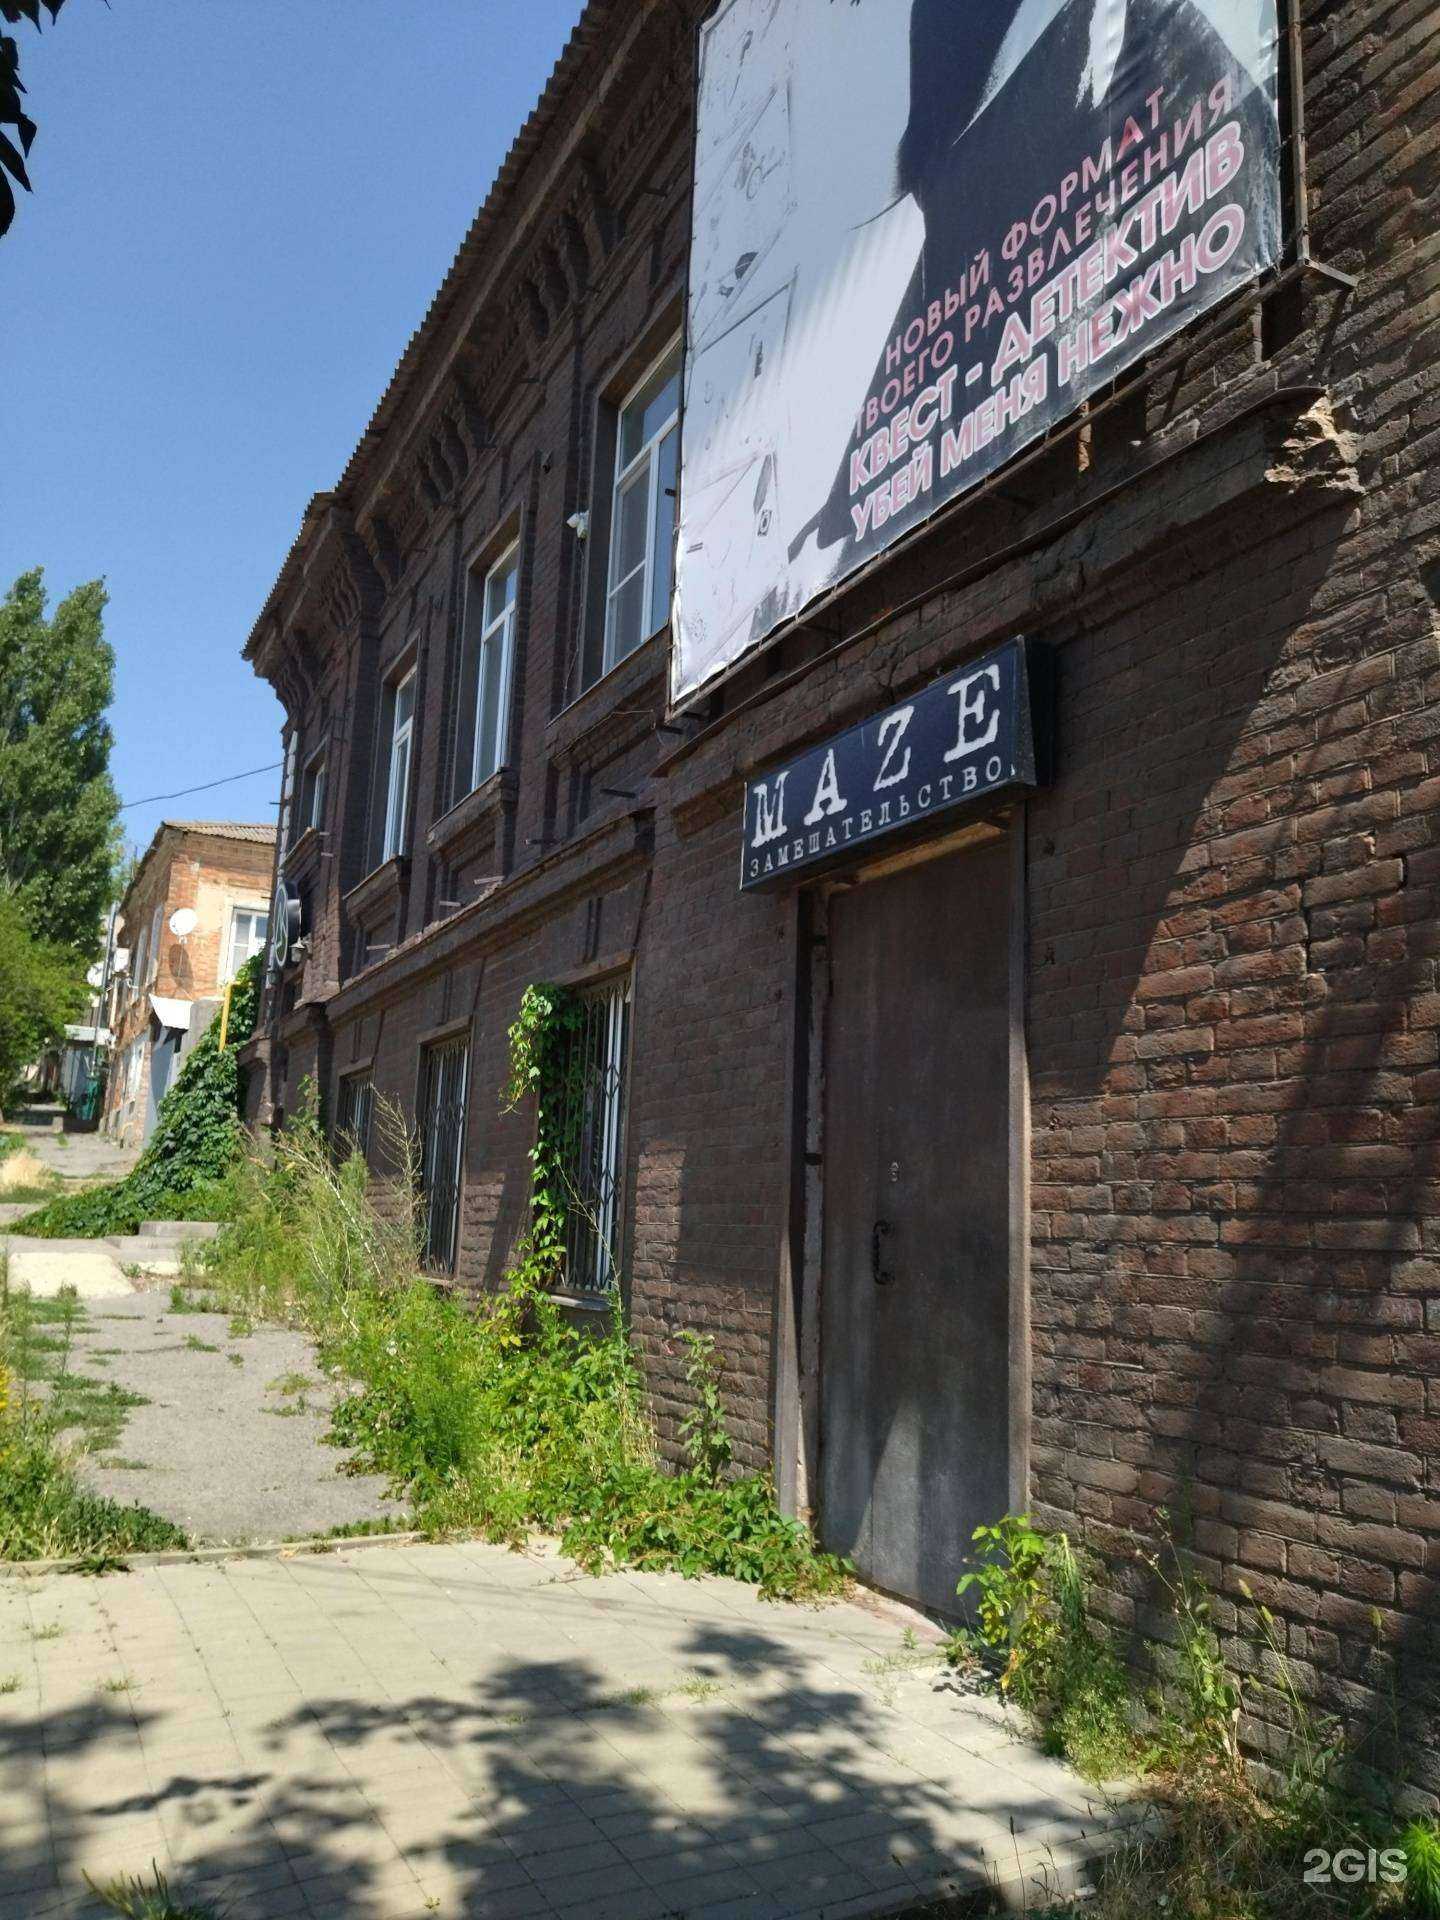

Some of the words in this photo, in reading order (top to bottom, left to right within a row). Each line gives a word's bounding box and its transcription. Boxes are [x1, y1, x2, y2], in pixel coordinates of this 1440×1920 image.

[850, 364, 958, 495] КВЕСТ
[991, 120, 1245, 387] ДЕТЕКТИВ
[850, 440, 933, 542] УБЕЙ
[940, 353, 1047, 478] МЕНЯ
[1058, 203, 1246, 387] НЕЖНО
[855, 331, 954, 440] ТВОЕГО
[965, 75, 1233, 343] РАЗВЛЕЧЕНИЯ
[885, 247, 990, 375] НОВЫЙ
[1002, 86, 1164, 259] ФОРМАТ
[750, 756, 1001, 877] ЗАМЕШАТЕЛЬСТВО
[751, 664, 1000, 848] MAZE
